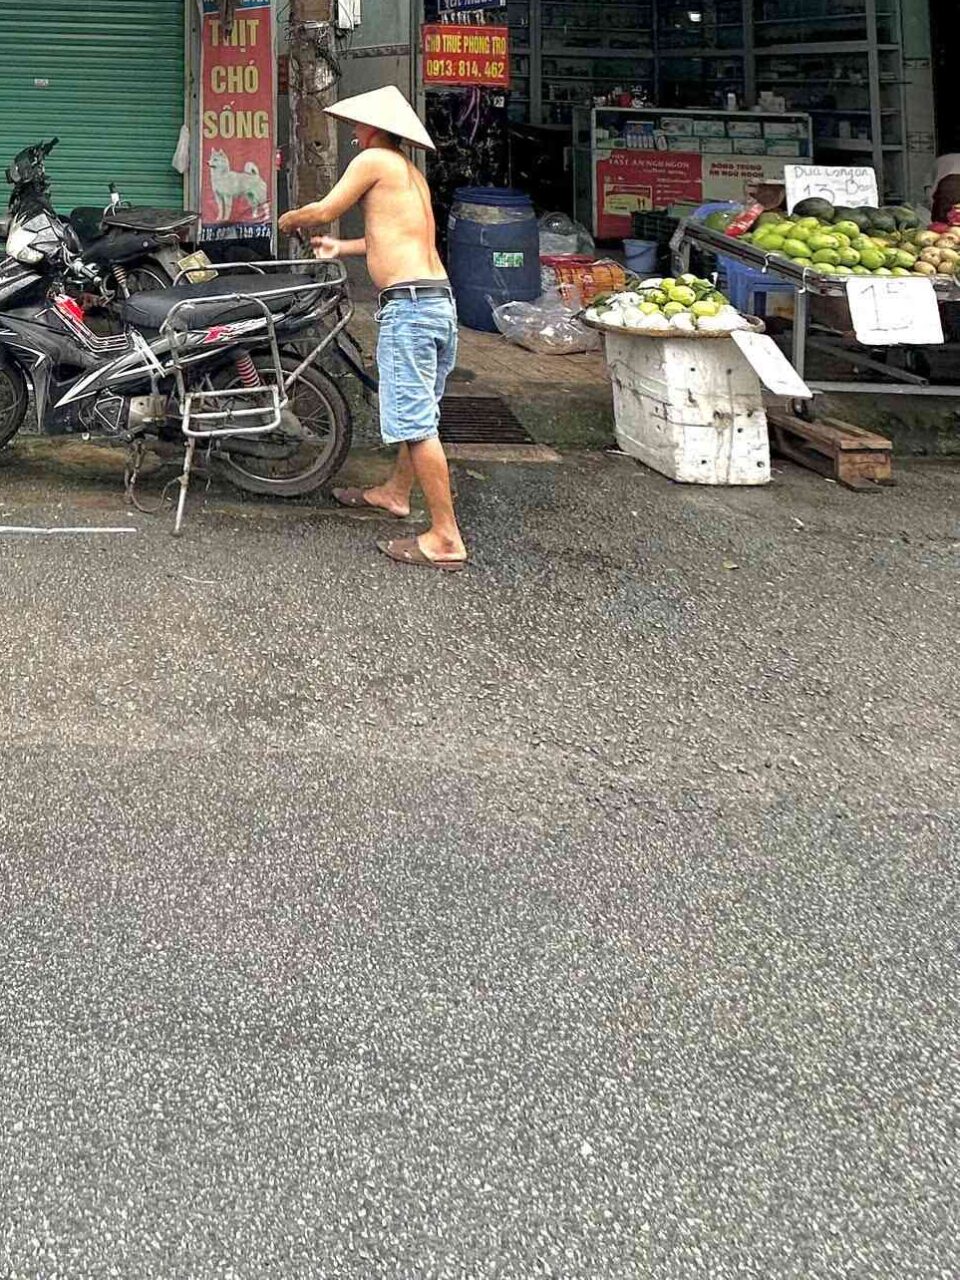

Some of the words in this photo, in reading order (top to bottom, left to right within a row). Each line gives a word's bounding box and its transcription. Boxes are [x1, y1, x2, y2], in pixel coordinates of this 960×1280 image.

[209, 19, 259, 53] THỊT
[211, 60, 259, 94] CHÓ
[427, 60, 456, 77] 0913.
[458, 60, 481, 77] 814.
[484, 61, 504, 78] 462
[203, 101, 269, 139] SỐNG
